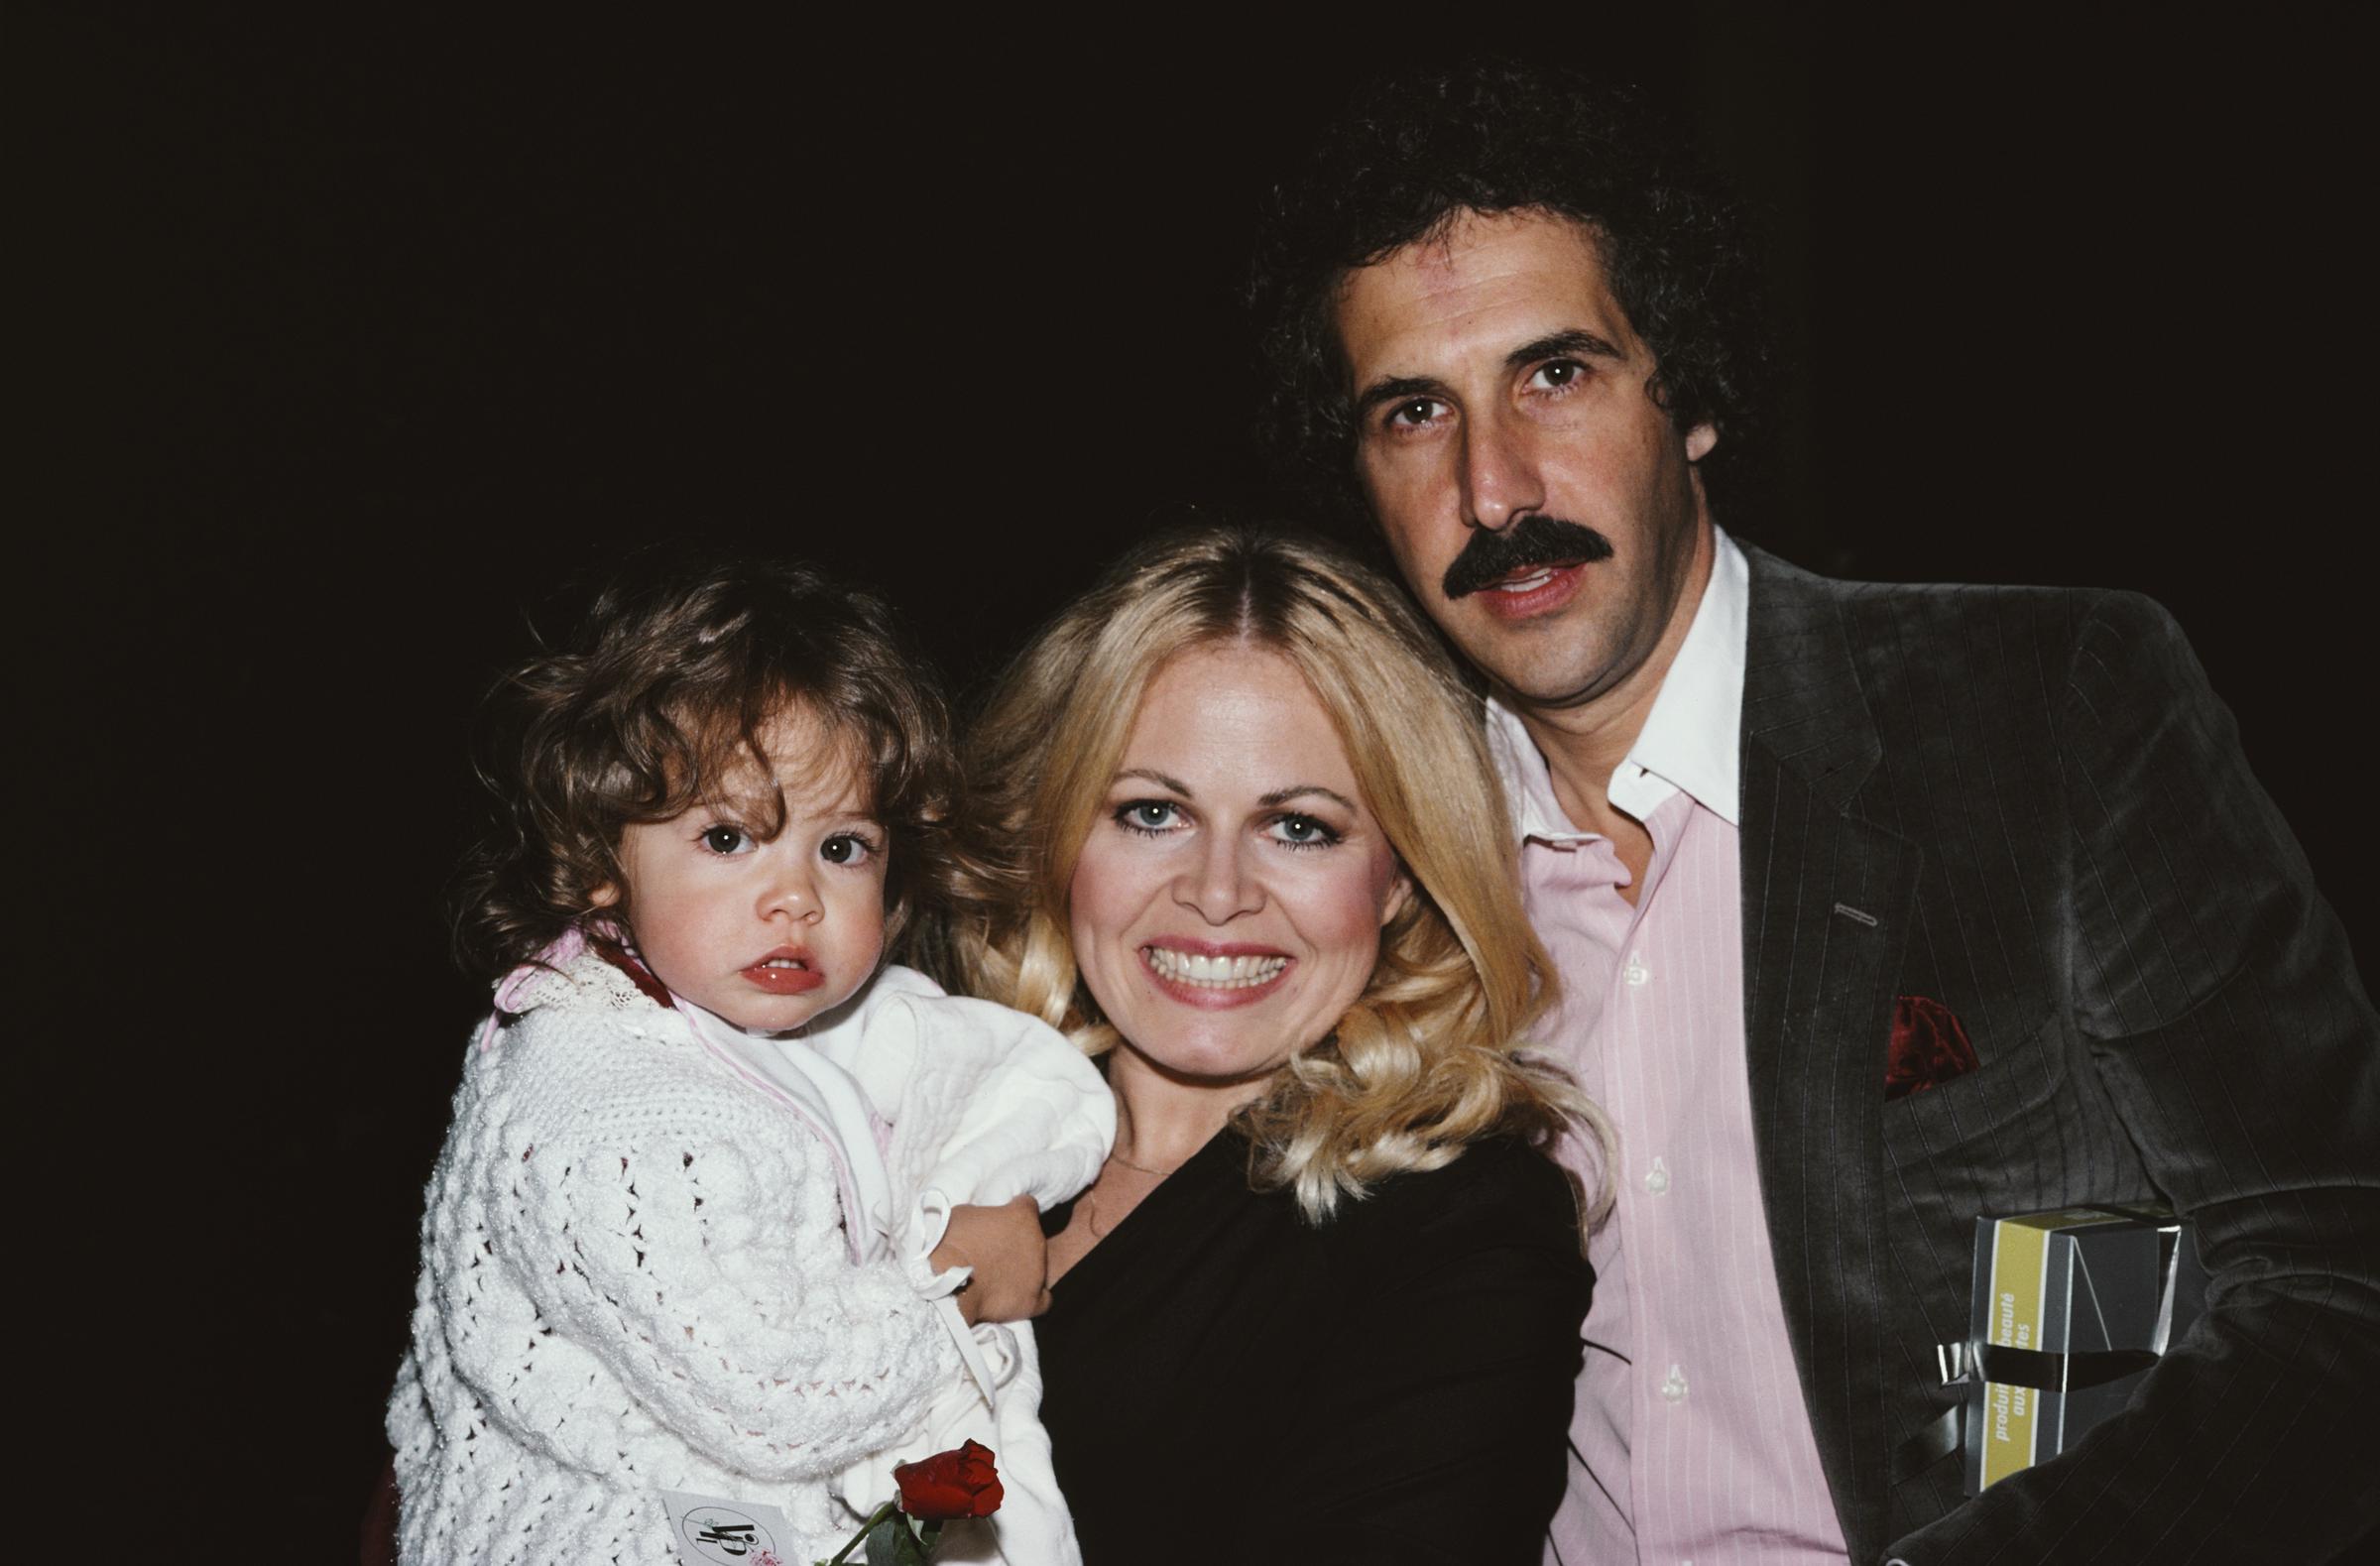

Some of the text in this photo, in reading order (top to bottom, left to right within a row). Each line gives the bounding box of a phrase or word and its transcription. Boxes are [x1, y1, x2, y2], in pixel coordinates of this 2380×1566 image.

[1997, 1292, 2015, 1347] beauté
[2013, 1324, 2031, 1416] aux tes
